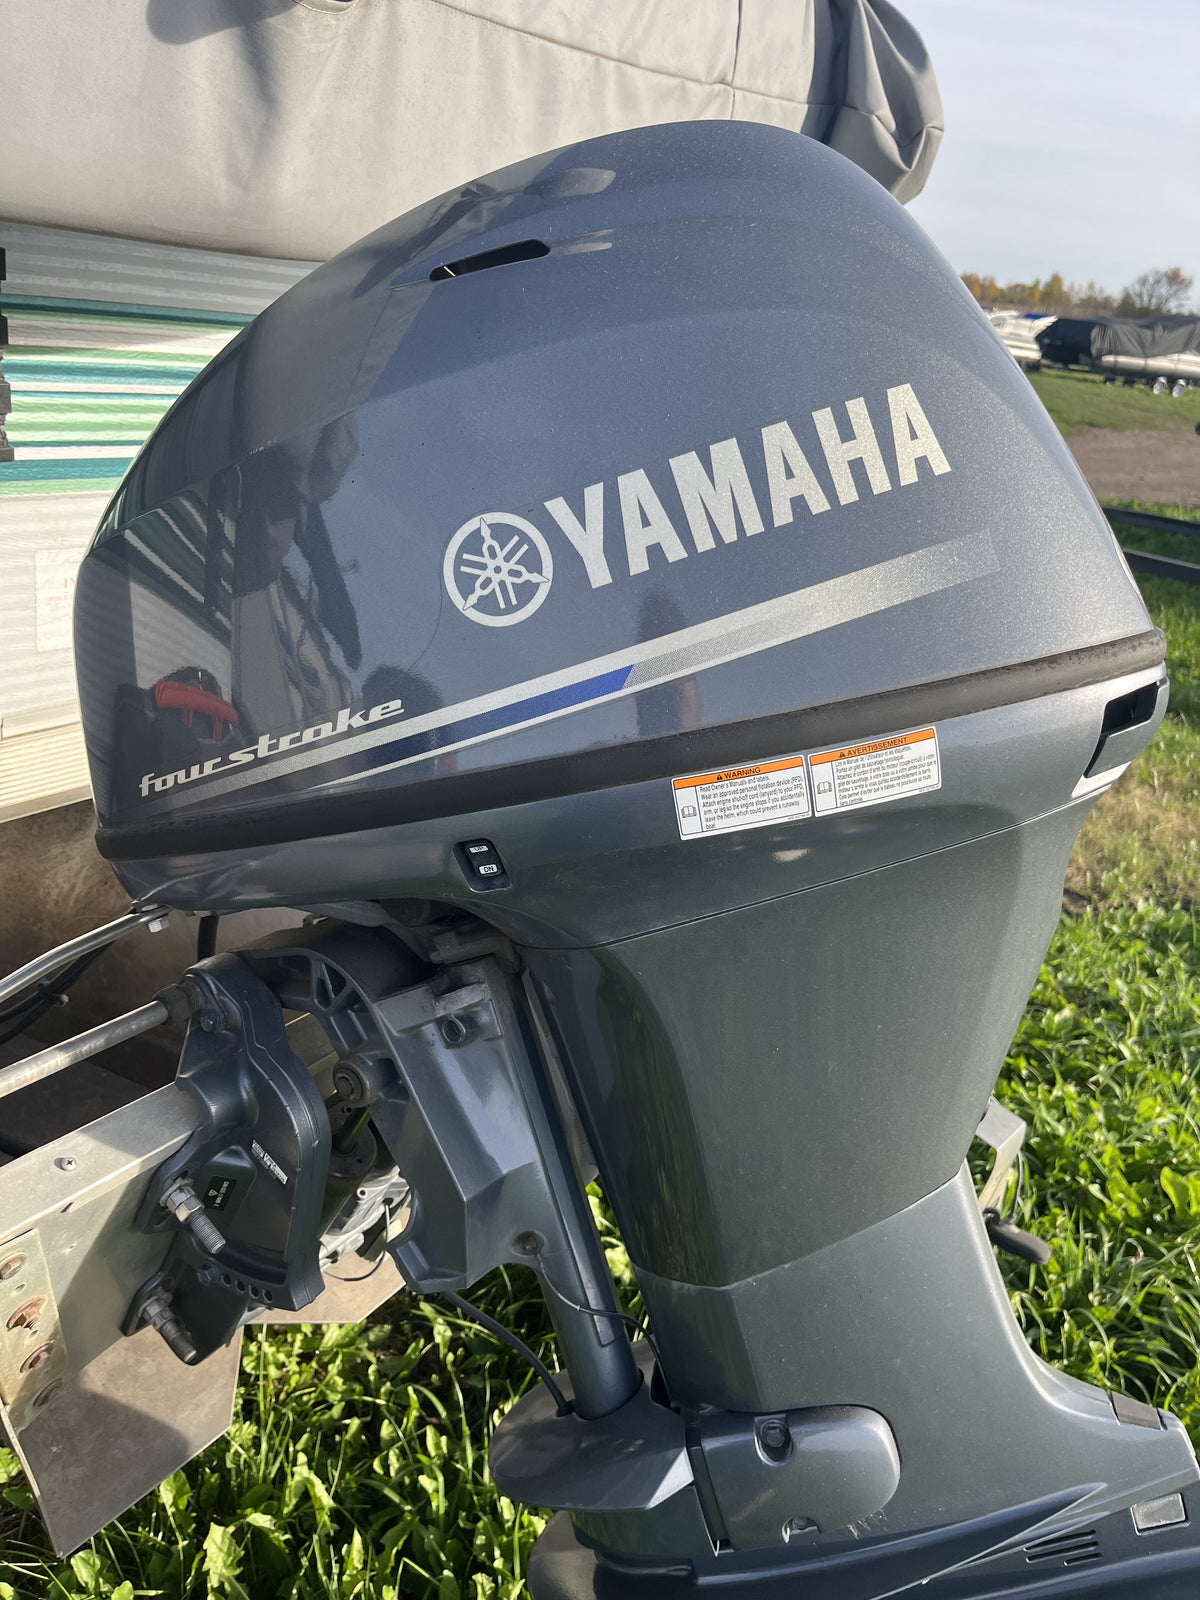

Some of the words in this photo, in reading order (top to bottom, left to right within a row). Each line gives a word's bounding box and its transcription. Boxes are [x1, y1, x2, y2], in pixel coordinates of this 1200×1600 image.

[543, 383, 952, 589] YAMAHA
[847, 737, 908, 756] AVERTISSEMENT
[725, 767, 761, 779] WARNING
[483, 865, 494, 873] DN
